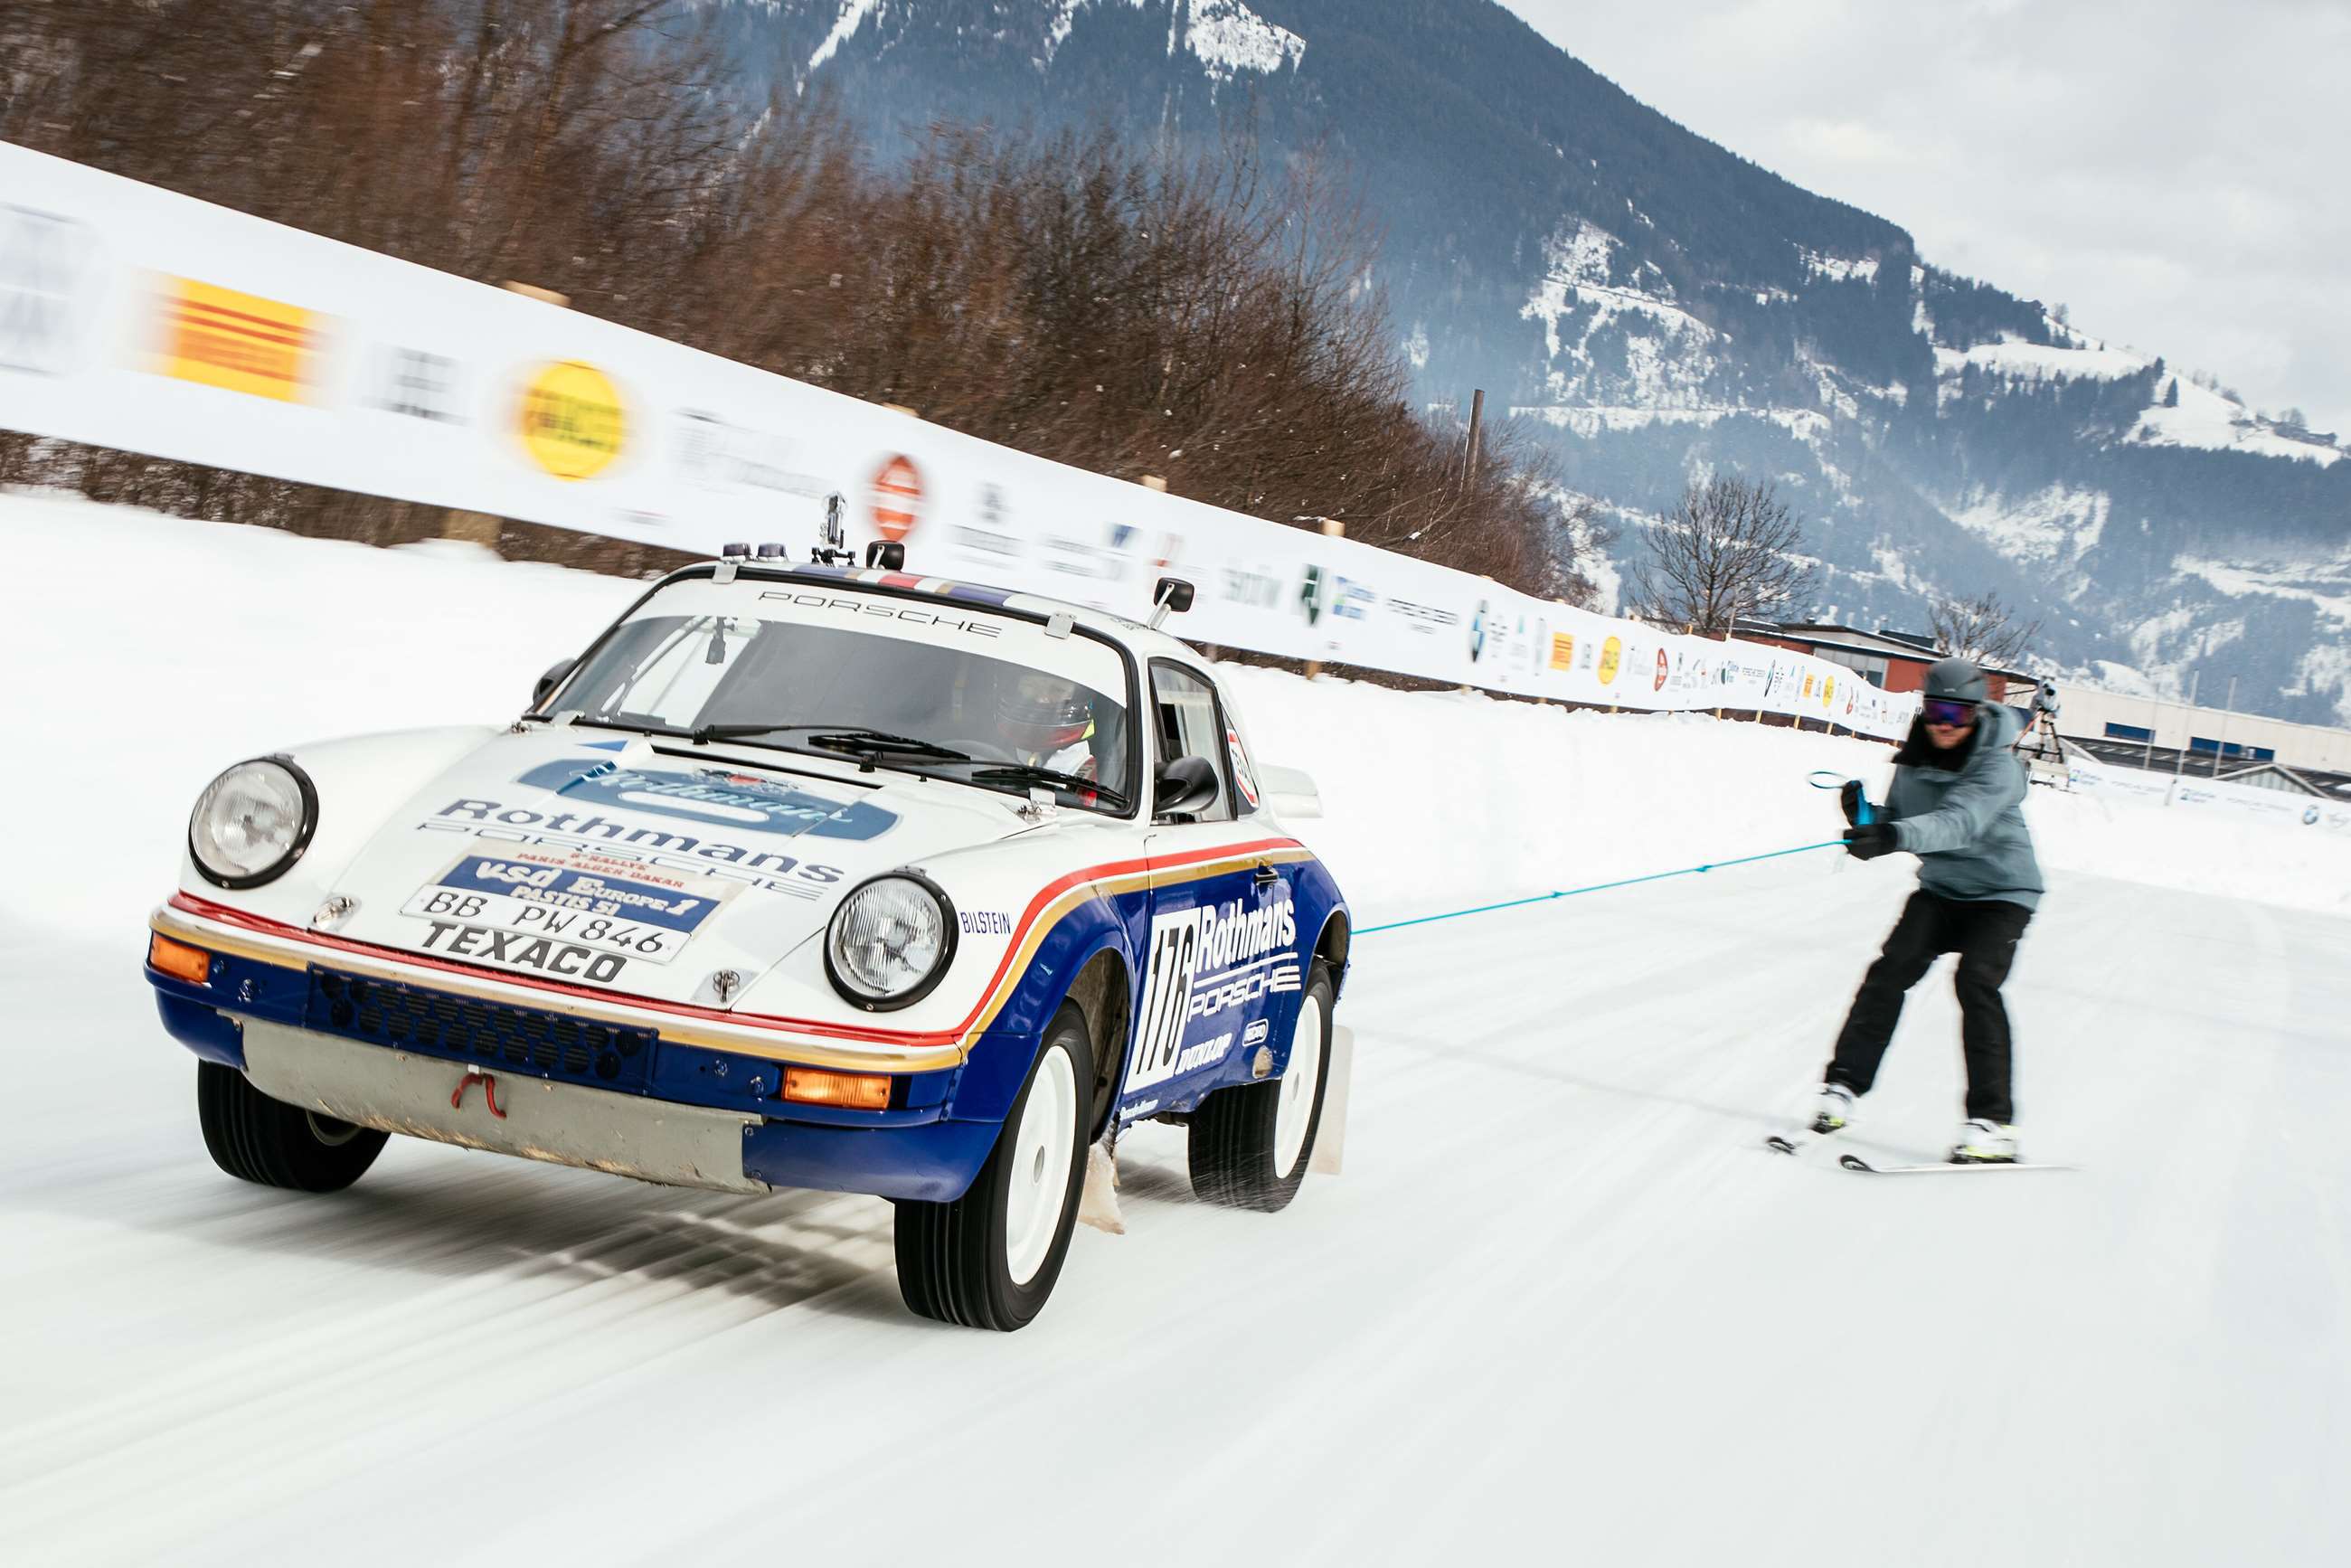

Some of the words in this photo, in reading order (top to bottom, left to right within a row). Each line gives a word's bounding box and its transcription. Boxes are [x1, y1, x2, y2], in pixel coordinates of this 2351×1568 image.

[758, 590, 1003, 638] PORSCHE
[436, 798, 845, 883] Rothmans
[423, 892, 488, 918] BB
[512, 906, 579, 934] PW
[580, 920, 664, 953] 846
[509, 885, 592, 911] PASTIS
[592, 902, 621, 916] 51
[960, 911, 1011, 934] BILSTEIN
[422, 921, 628, 983] TEXACO
[1194, 898, 1296, 974] Rothmans
[1136, 923, 1194, 1074] 176
[1187, 965, 1301, 1023] PORSCHE
[1175, 1033, 1232, 1075] DUNLOP
